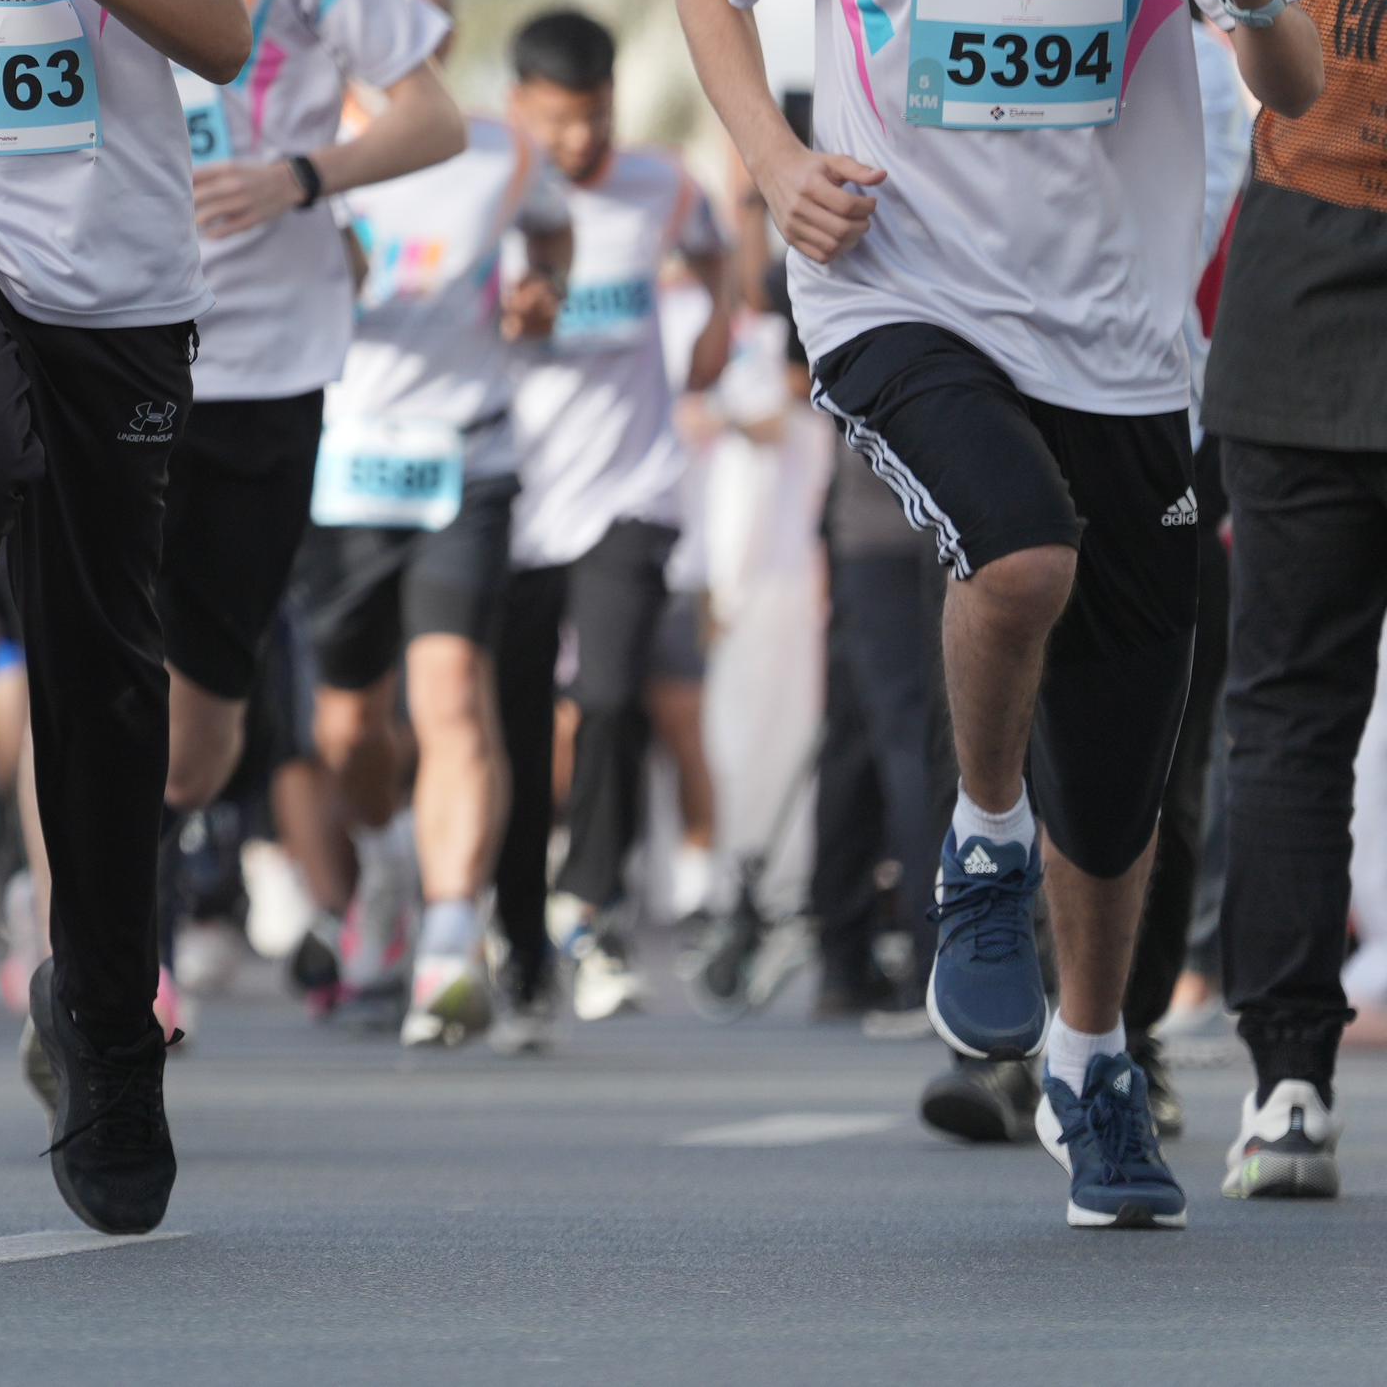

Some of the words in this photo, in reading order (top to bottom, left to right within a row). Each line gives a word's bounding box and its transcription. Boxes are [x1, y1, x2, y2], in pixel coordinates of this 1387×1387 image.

[947, 31, 1112, 88] 5394
[909, 93, 939, 110] KM
[187, 113, 215, 155] 5
[117, 432, 146, 443] UNDER
[1161, 510, 1198, 526] adid
[964, 862, 998, 875] adidas
